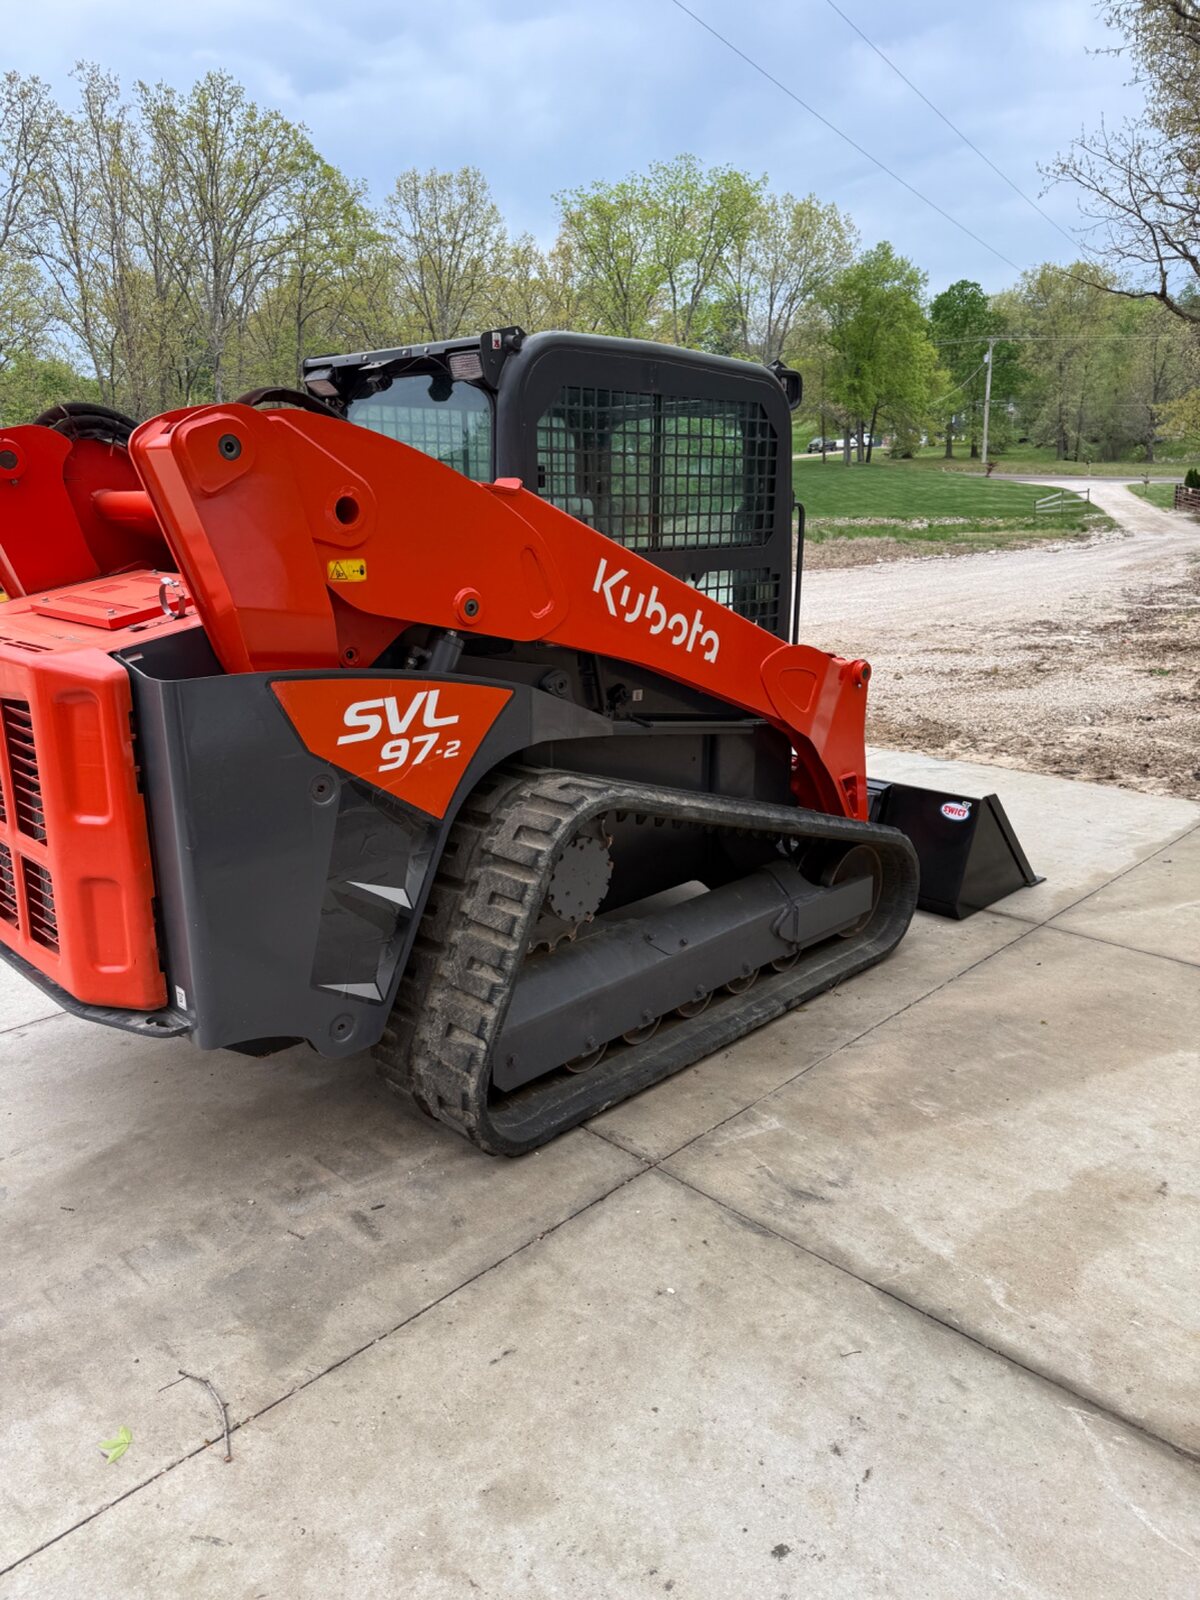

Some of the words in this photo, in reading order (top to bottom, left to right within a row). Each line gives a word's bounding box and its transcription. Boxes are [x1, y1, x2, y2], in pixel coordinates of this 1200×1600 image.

[592, 557, 720, 664] Kubota
[336, 688, 460, 746] SVL
[378, 732, 461, 773] 97-2
